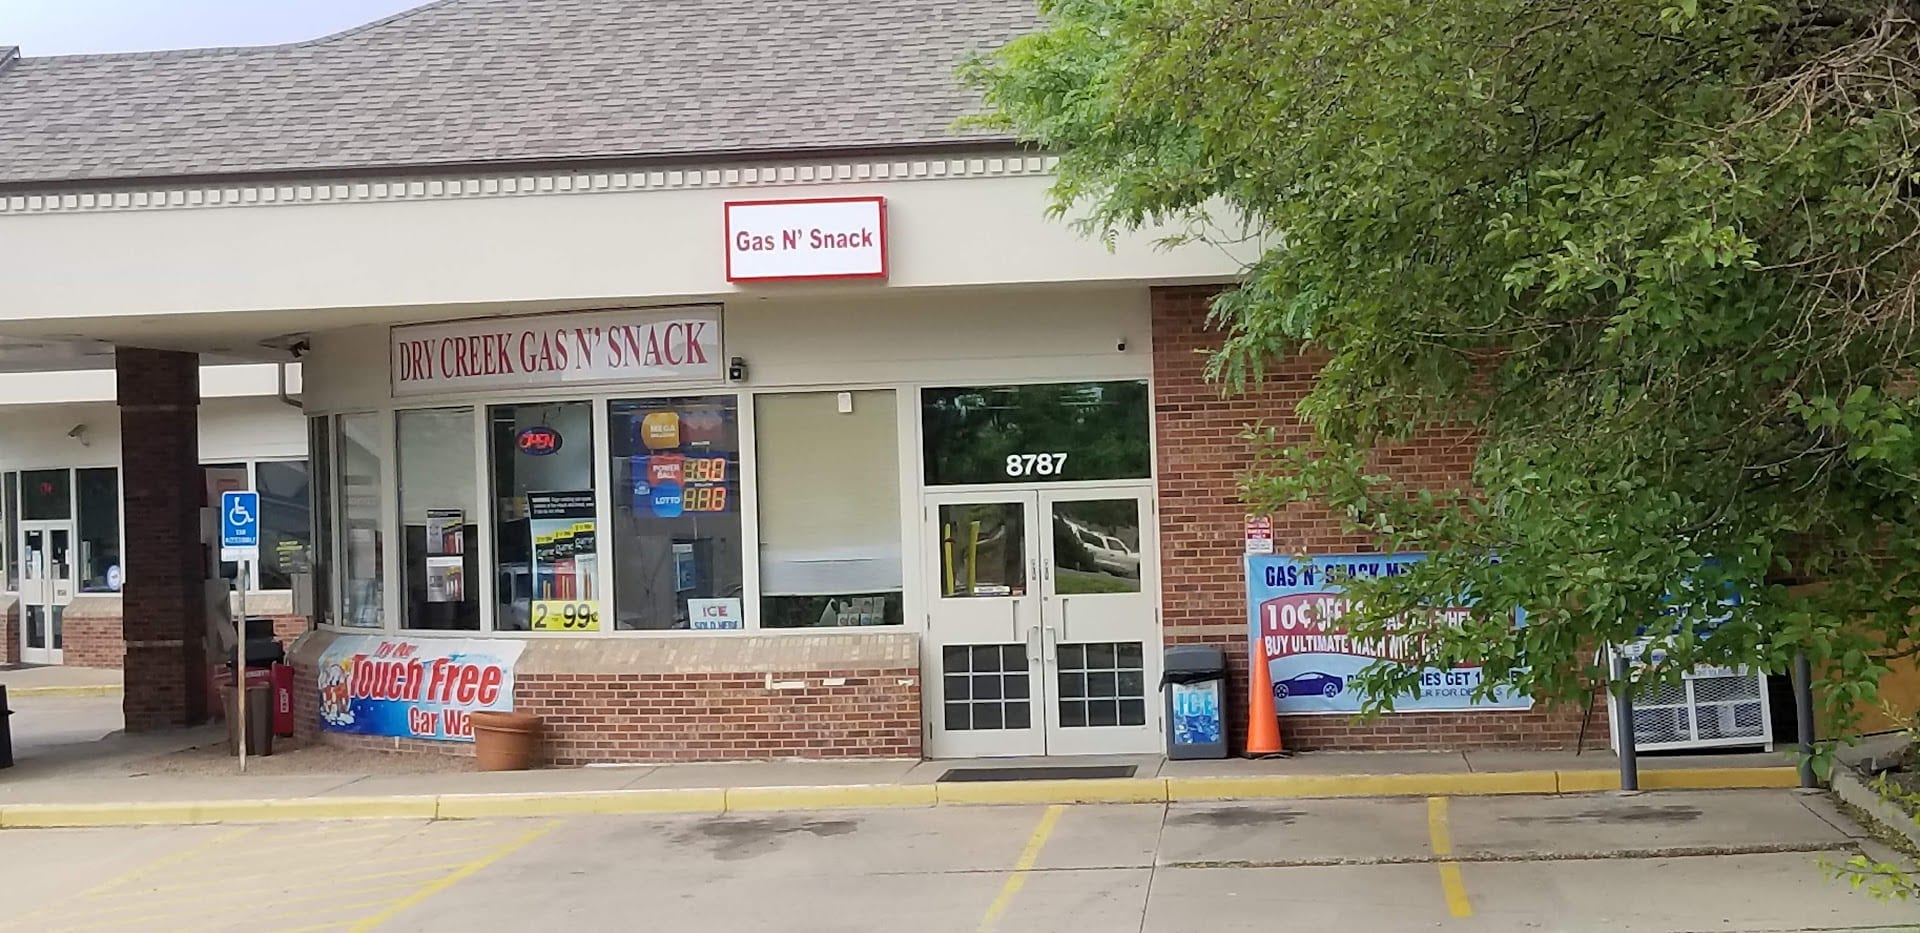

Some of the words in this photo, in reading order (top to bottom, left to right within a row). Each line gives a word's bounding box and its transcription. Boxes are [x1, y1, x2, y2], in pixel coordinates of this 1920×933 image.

[736, 230, 775, 252] Gas
[782, 228, 803, 251] N'
[810, 226, 873, 249] Snack
[399, 338, 436, 381] DRY
[440, 332, 515, 379] CREEK
[519, 328, 569, 373] GAS
[574, 326, 600, 370] N'
[607, 321, 708, 369] SNACK
[650, 424, 676, 433] MEGA
[519, 433, 556, 449] OPEN
[652, 464, 680, 472] POWER
[1006, 453, 1067, 477] 8787
[655, 496, 681, 505] LOTTO
[1265, 566, 1297, 586] GAS
[534, 604, 548, 628] 2
[563, 603, 599, 629] 99¢
[702, 606, 728, 617] ICE
[1267, 600, 1312, 630] 10¢
[1315, 598, 1343, 632] OFF
[694, 621, 717, 629] SOLD
[374, 641, 396, 658] Try
[1265, 635, 1289, 656] BUY
[1291, 635, 1349, 654] ULTIMATE
[351, 654, 424, 701] Touch
[427, 658, 504, 704] Free
[1445, 671, 1471, 686] GET
[1474, 671, 1481, 685] 1
[1435, 688, 1458, 698] FOR
[1177, 691, 1216, 716] ICE
[408, 707, 439, 735] Car
[443, 708, 476, 737] Wa
